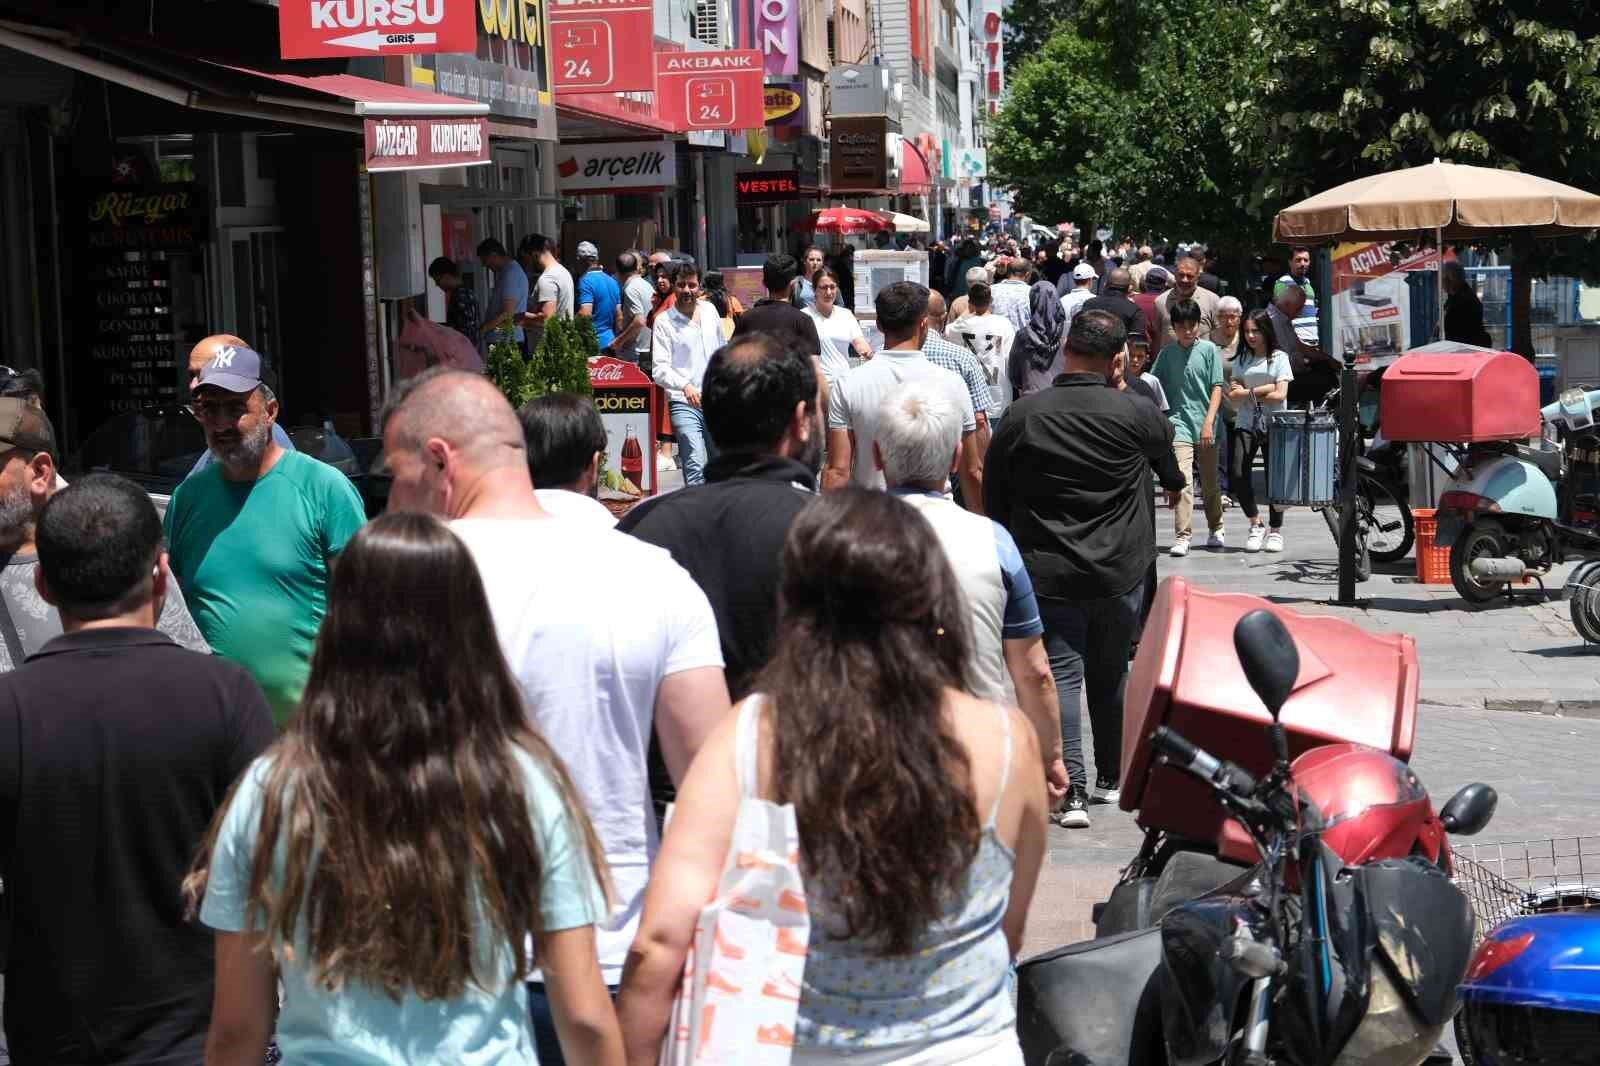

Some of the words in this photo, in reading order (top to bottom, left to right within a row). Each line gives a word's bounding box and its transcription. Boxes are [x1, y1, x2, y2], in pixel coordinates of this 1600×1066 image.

[311, 0, 443, 28] KURSU
[563, 60, 592, 79] 24
[667, 56, 752, 69] AKBANK
[764, 92, 793, 106] atis
[700, 106, 721, 120] 24
[375, 120, 418, 155] RÜZGAR
[584, 151, 665, 181] arçelik
[739, 180, 797, 193] VESTEL
[88, 191, 191, 225] Rüzgar
[595, 391, 647, 410] döner
